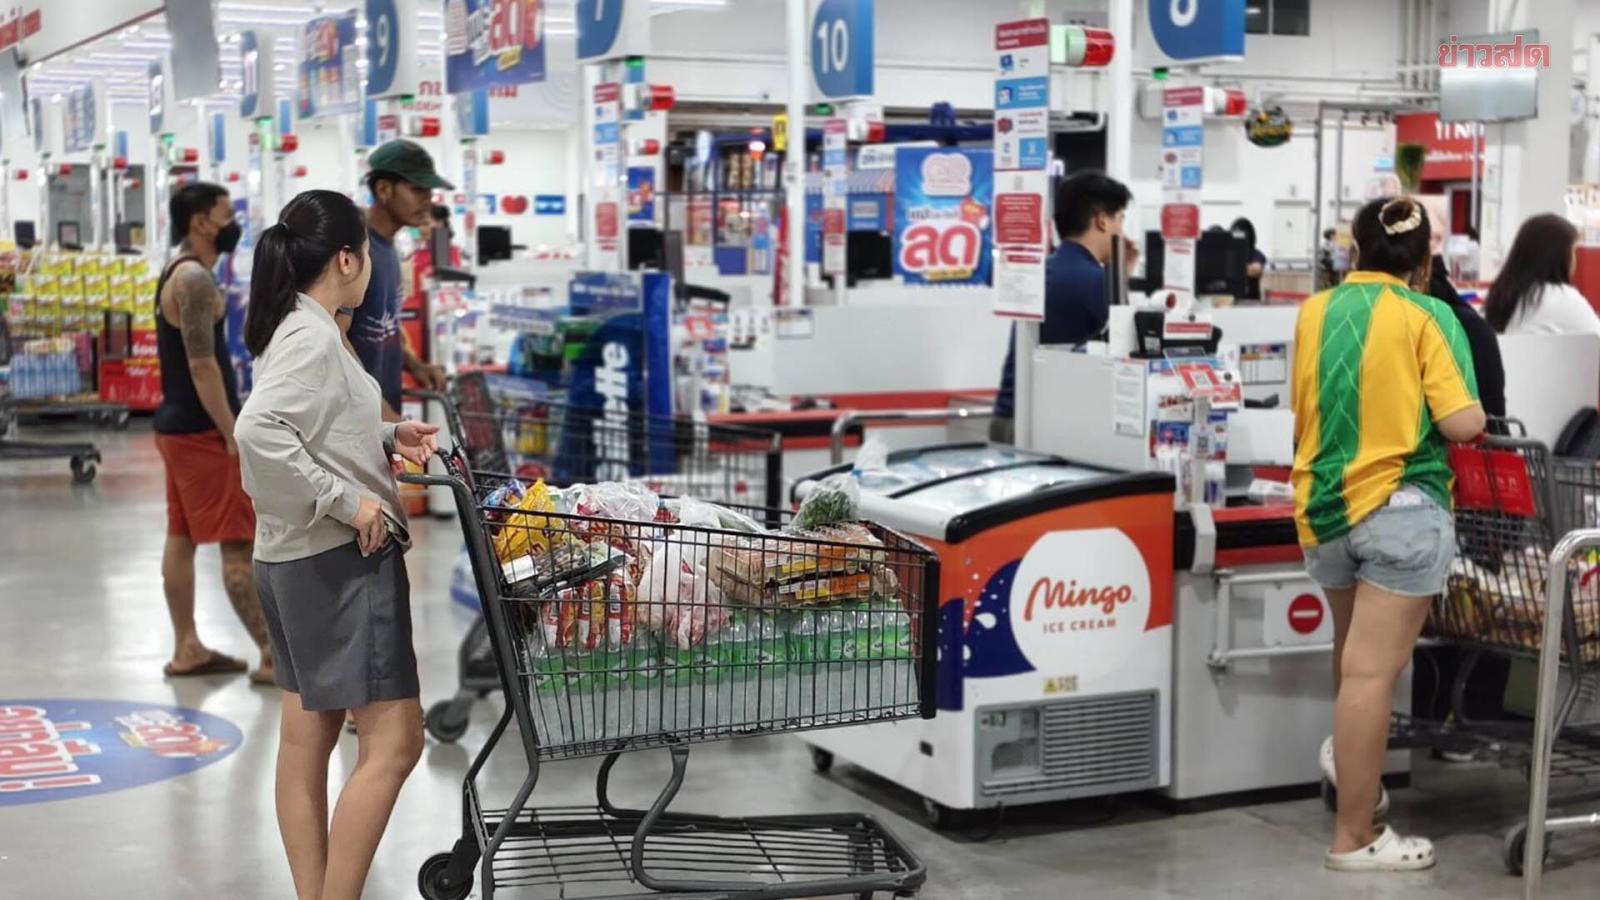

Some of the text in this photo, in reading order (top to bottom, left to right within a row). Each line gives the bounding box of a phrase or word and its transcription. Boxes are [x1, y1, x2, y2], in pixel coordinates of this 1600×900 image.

[376, 13, 390, 68] 9
[817, 18, 849, 75] 10
[902, 224, 979, 270] ลด
[1024, 576, 1132, 622] Mingo
[1043, 617, 1116, 634] ICE CREAM
